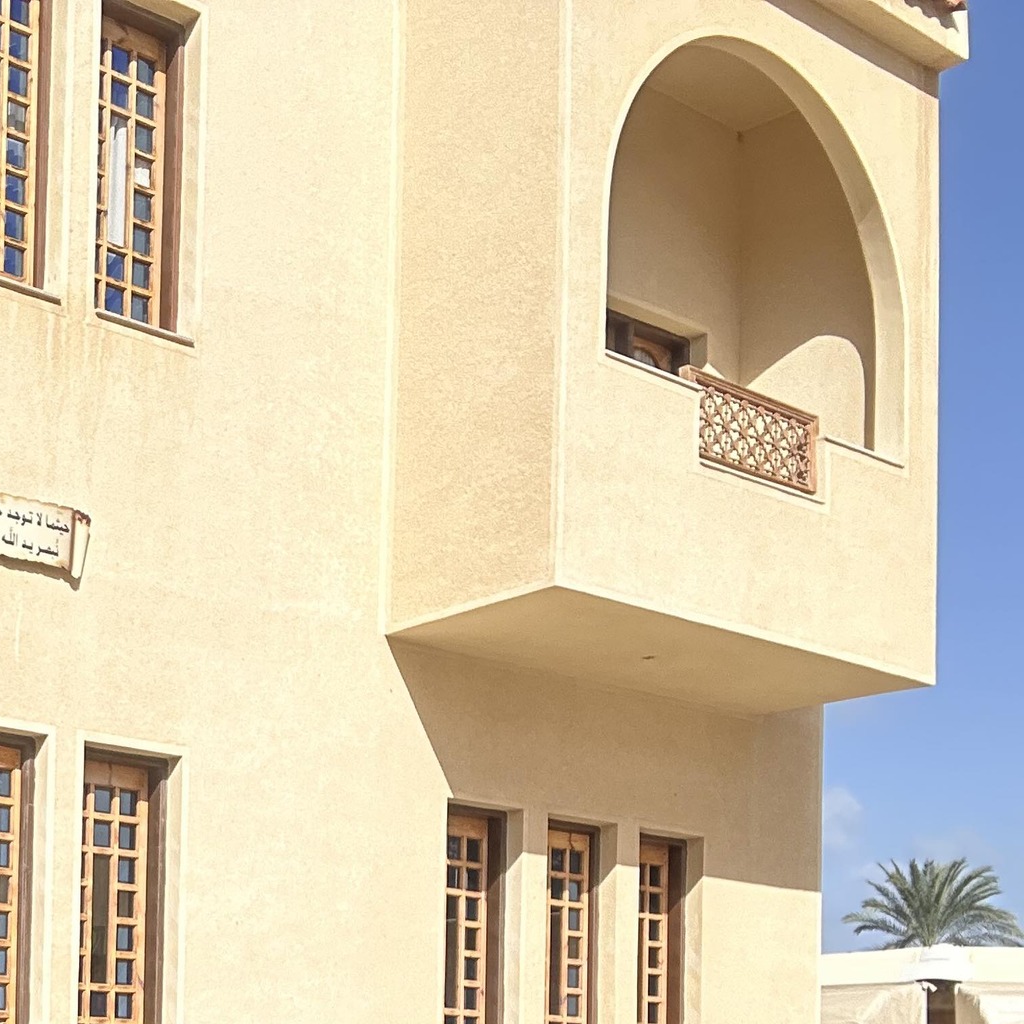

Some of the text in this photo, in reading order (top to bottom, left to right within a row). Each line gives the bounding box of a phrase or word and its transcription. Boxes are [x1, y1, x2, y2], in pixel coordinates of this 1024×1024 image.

[7, 508, 33, 526] توجد
[36, 512, 43, 527] لا
[45, 513, 71, 536] حيثما
[1, 526, 19, 547] الله
[21, 538, 34, 555] يد
